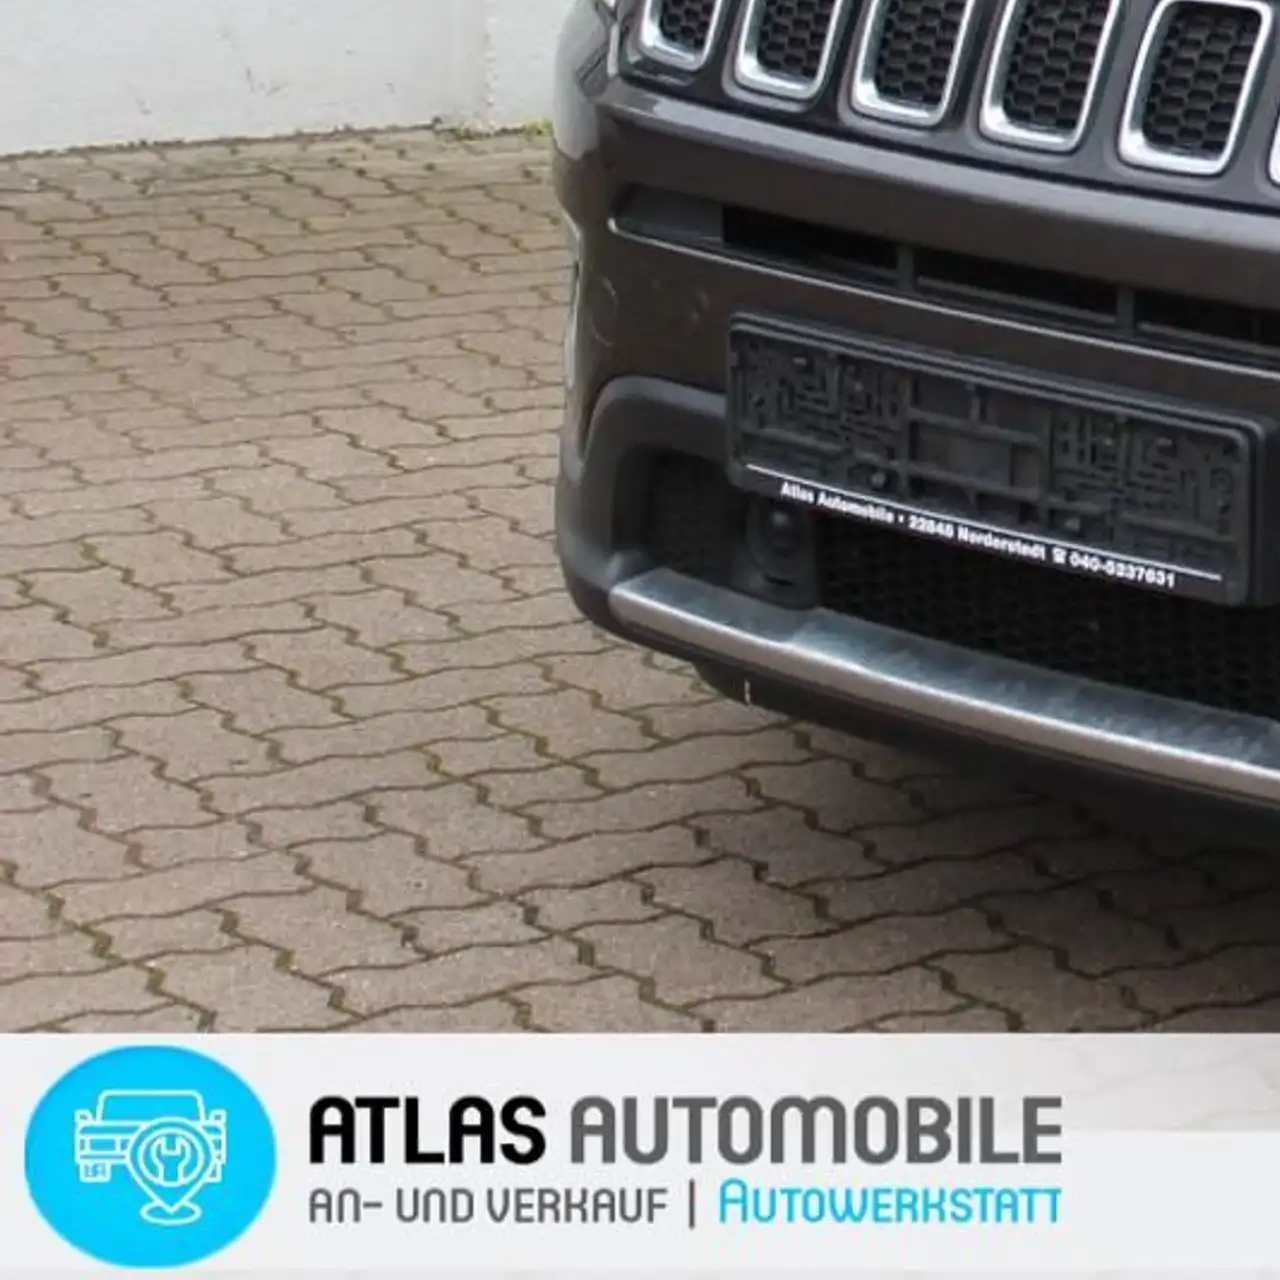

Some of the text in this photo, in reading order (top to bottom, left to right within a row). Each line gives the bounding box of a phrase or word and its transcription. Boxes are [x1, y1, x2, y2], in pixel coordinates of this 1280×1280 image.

[779, 480, 815, 504] Atlas
[816, 491, 895, 524] Automobile
[957, 525, 1047, 562] Norderstedt
